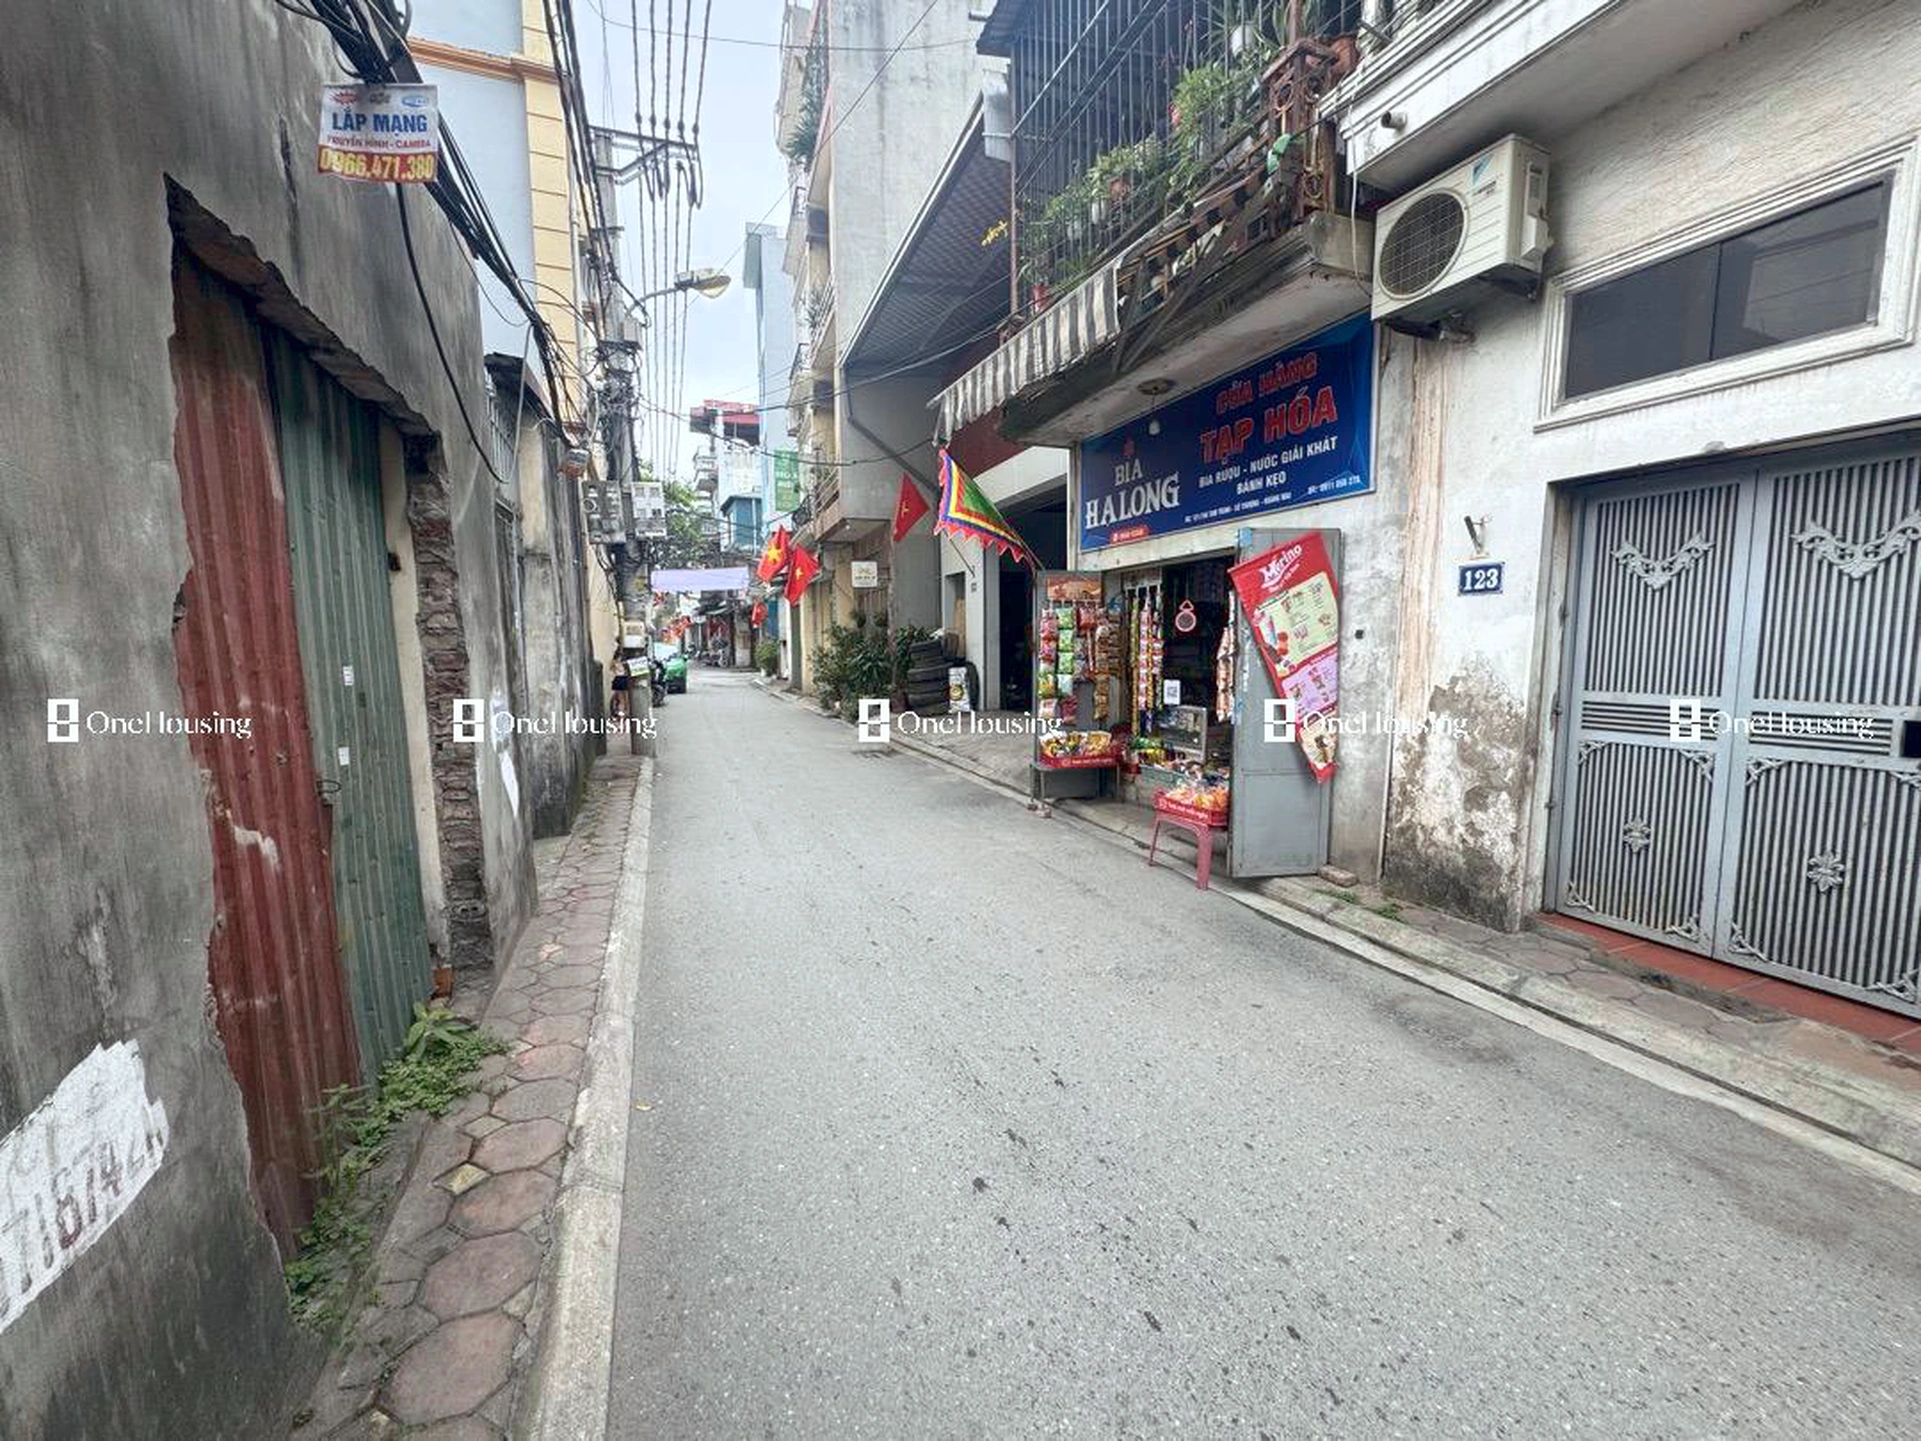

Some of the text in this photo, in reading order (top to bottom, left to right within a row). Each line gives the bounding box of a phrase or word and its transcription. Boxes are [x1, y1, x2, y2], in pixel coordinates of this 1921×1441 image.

[331, 105, 428, 137] LẮP MẠNG
[319, 146, 434, 180] 0966.471.380
[1199, 417, 1253, 466] TẠP
[1114, 458, 1143, 487] BIA
[1463, 568, 1499, 590] 123
